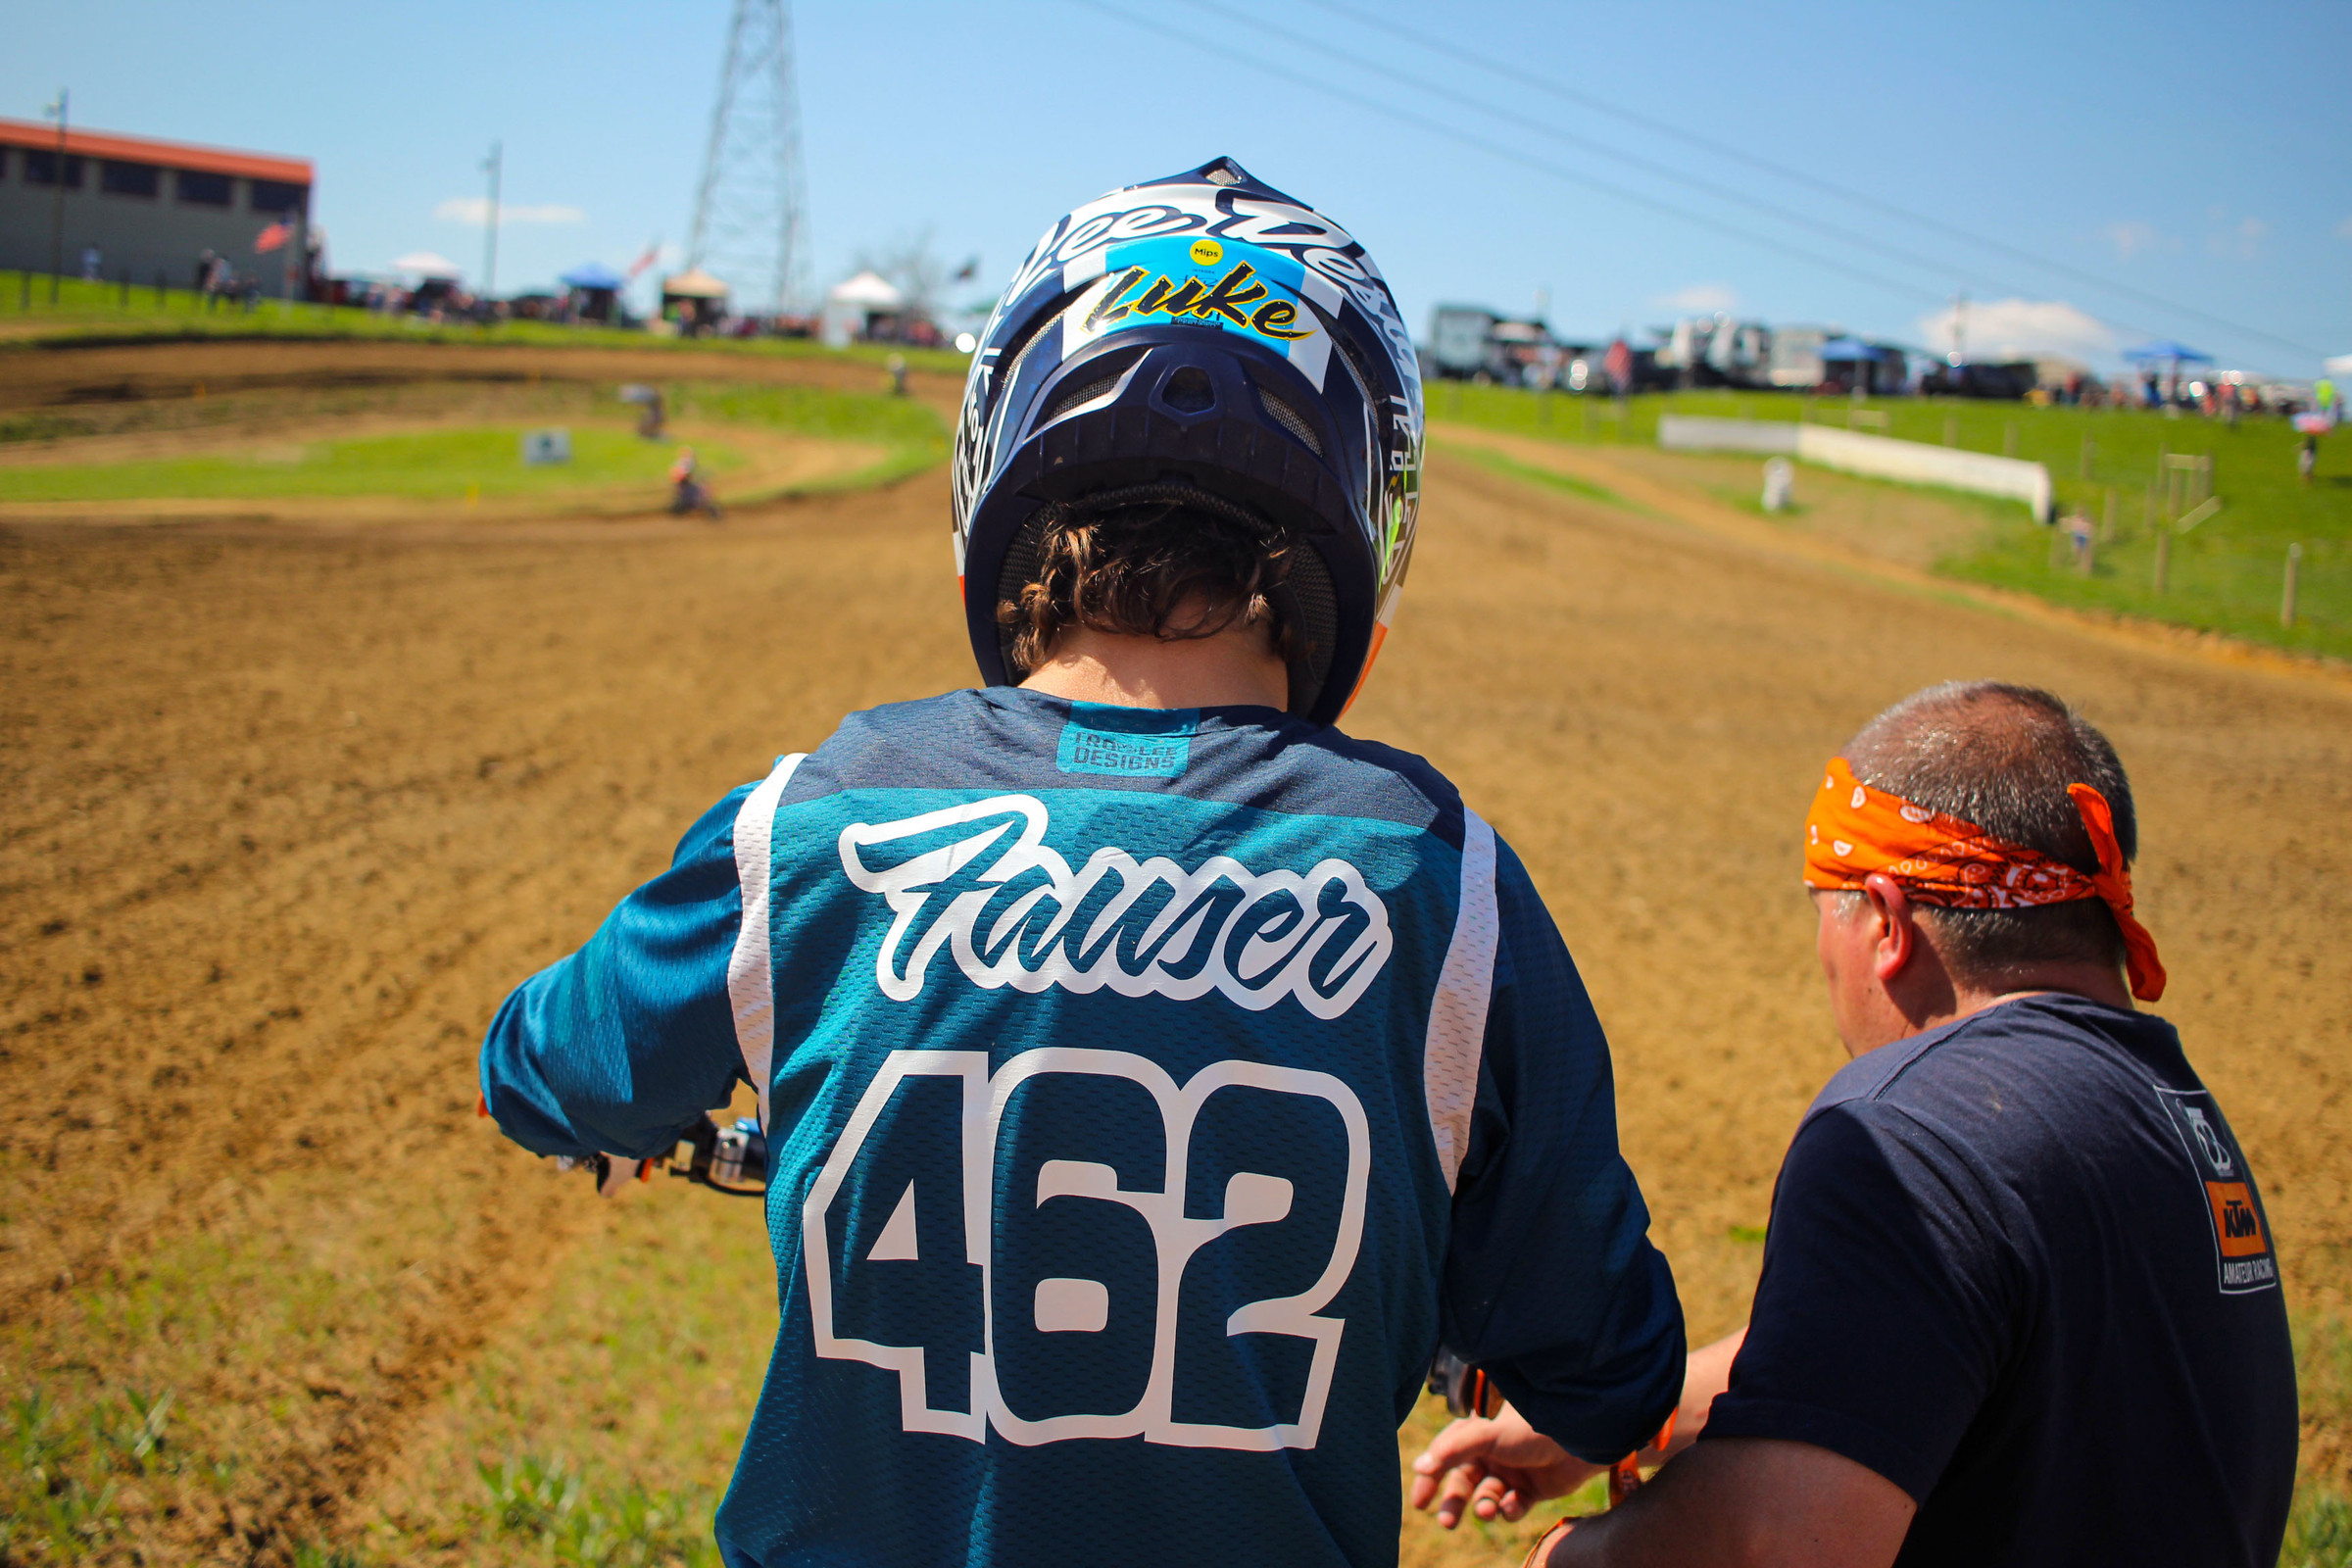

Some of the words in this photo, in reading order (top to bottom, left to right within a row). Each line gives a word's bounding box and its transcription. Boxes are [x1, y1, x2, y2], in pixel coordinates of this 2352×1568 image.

[1194, 247, 1219, 258] Mips
[1080, 259, 1319, 343] Luke
[1073, 746, 1176, 770] DESIGNS
[838, 793, 1394, 1020] Fauser
[2223, 1200, 2256, 1238] KTM
[803, 1047, 1371, 1452] 462
[2224, 1260, 2253, 1284] AMATEUR
